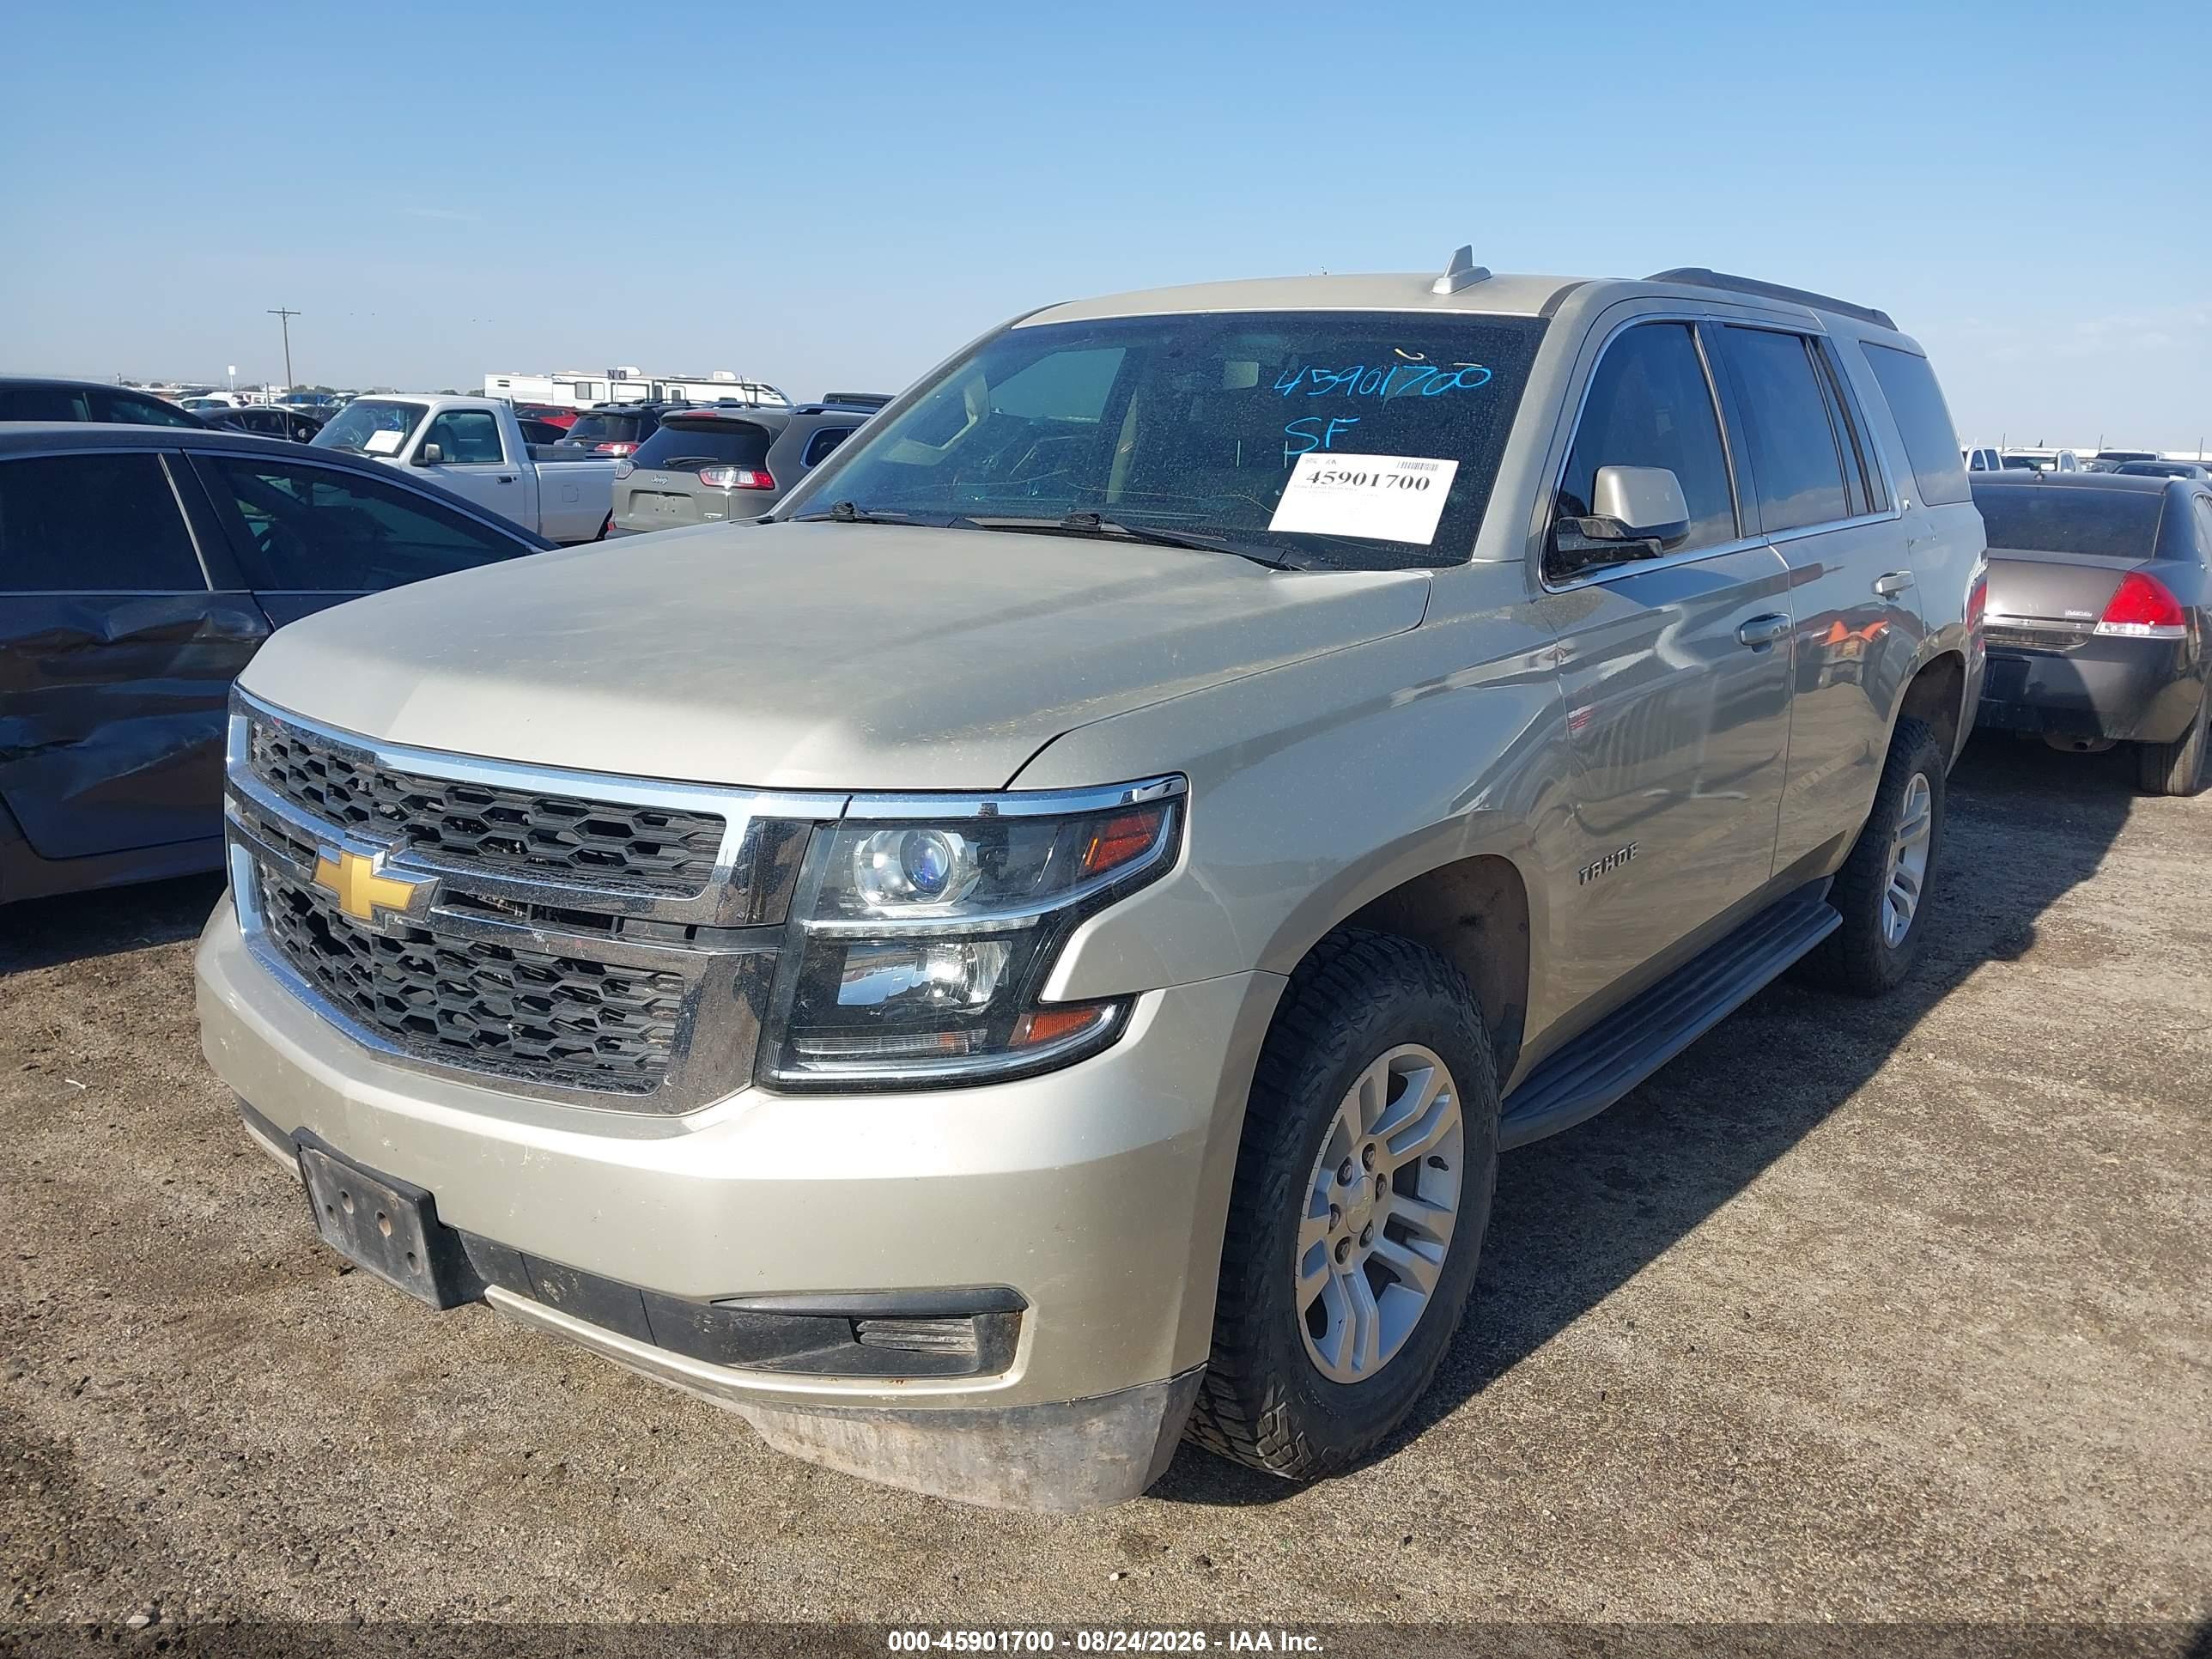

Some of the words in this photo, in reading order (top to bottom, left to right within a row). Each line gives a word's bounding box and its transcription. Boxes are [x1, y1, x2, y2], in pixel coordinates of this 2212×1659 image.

[1274, 365, 1492, 397] 45901700
[1285, 417, 1361, 454] SF
[1306, 470, 1431, 492] 45901700
[1578, 841, 1638, 885] TAHOE
